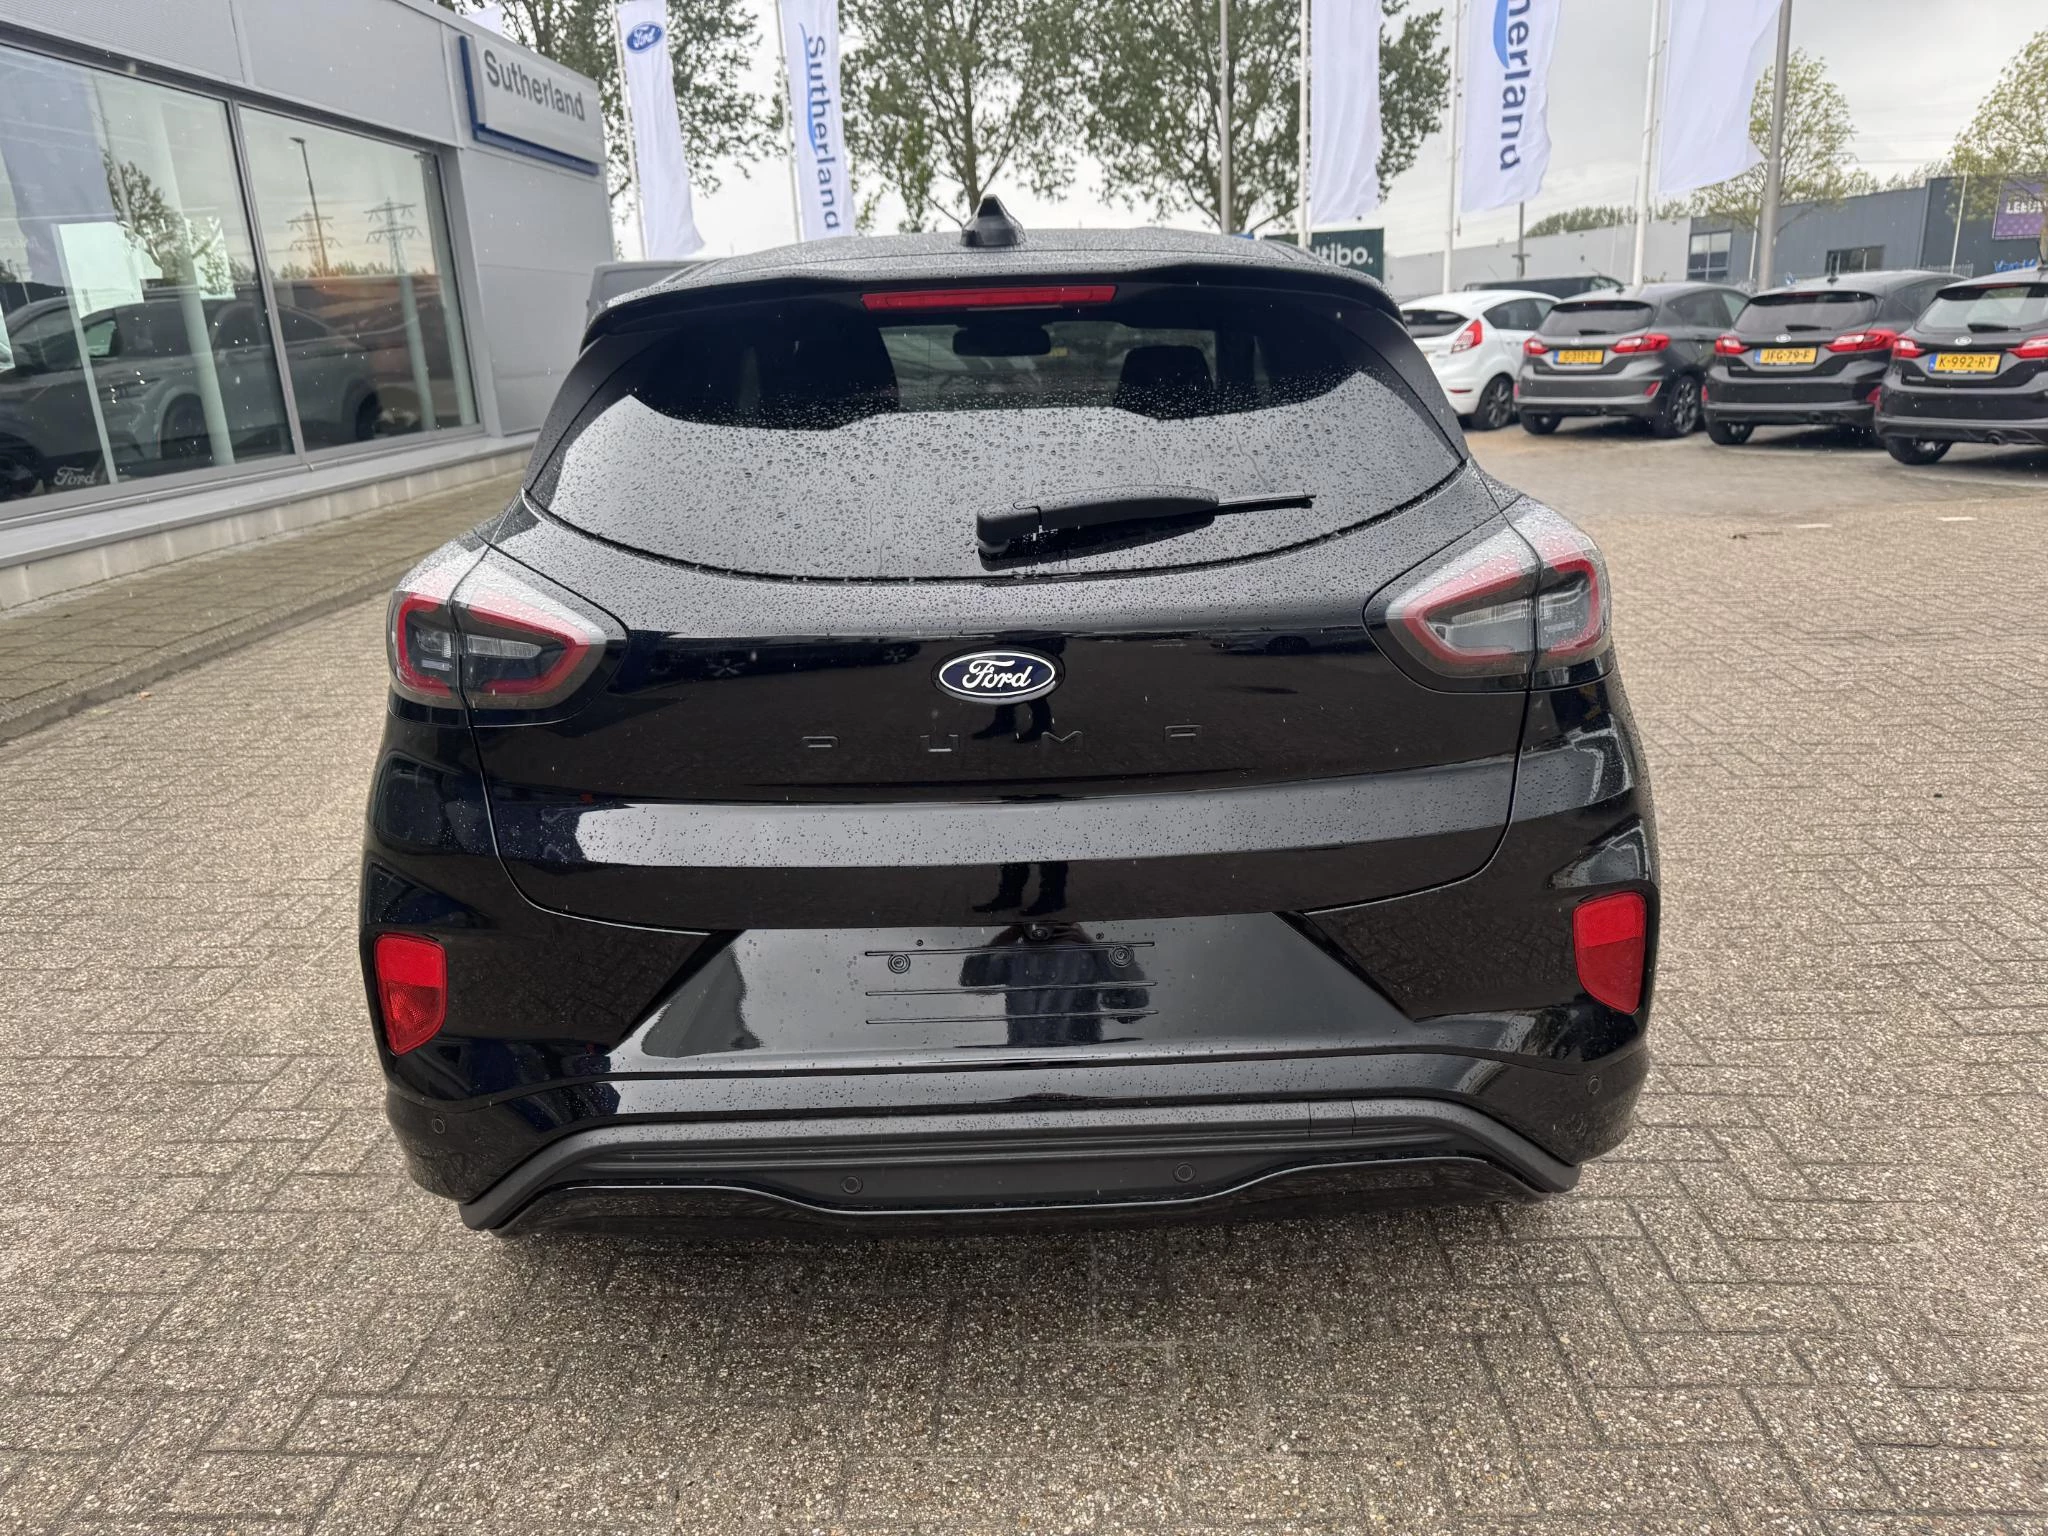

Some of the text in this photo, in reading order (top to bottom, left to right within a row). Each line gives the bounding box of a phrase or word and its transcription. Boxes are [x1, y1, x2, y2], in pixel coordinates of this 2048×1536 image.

[484, 49, 586, 121] Sutherland
[808, 35, 840, 230] Sutherland
[1938, 356, 1995, 369] K-992-RT
[54, 465, 97, 486] Ford
[962, 659, 1033, 689] Ford
